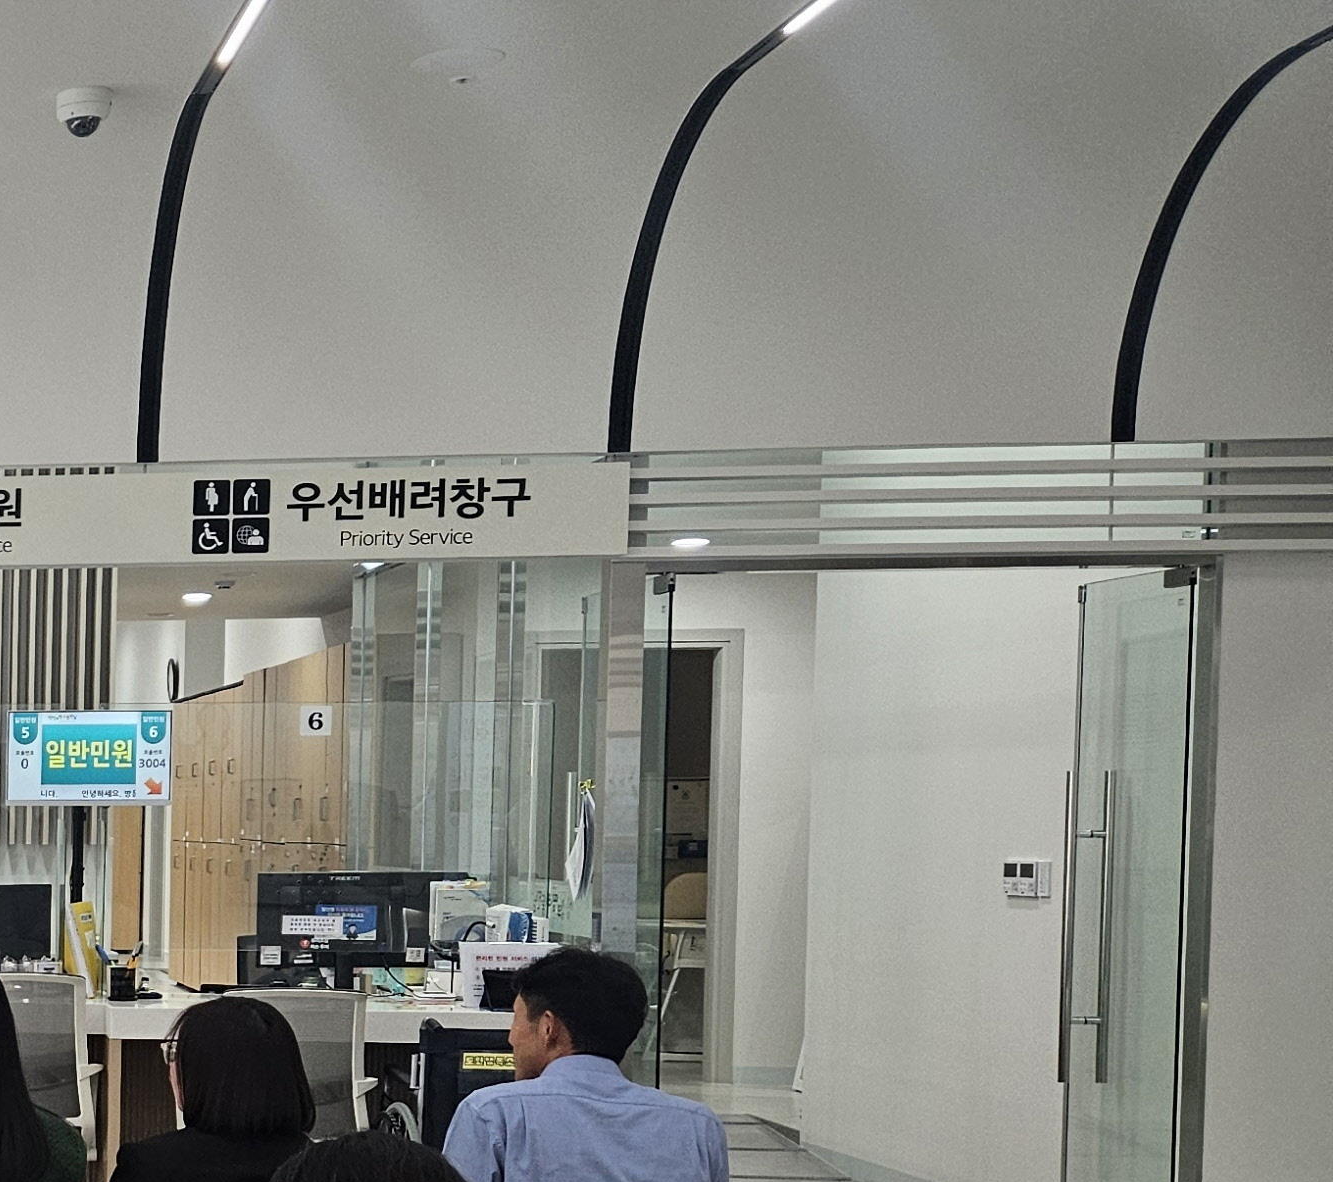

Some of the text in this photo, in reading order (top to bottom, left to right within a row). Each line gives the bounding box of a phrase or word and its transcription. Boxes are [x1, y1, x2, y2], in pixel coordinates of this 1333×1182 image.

[286, 478, 531, 522] 우선배려창구
[340, 528, 473, 549] Priority Service
[308, 711, 324, 731] 6
[21, 726, 30, 739] 5
[149, 726, 158, 738] 6
[45, 739, 133, 769] 일반민원
[20, 758, 29, 769] 0
[139, 758, 166, 769] 3004
[81, 789, 122, 798] 안녕하세요.
